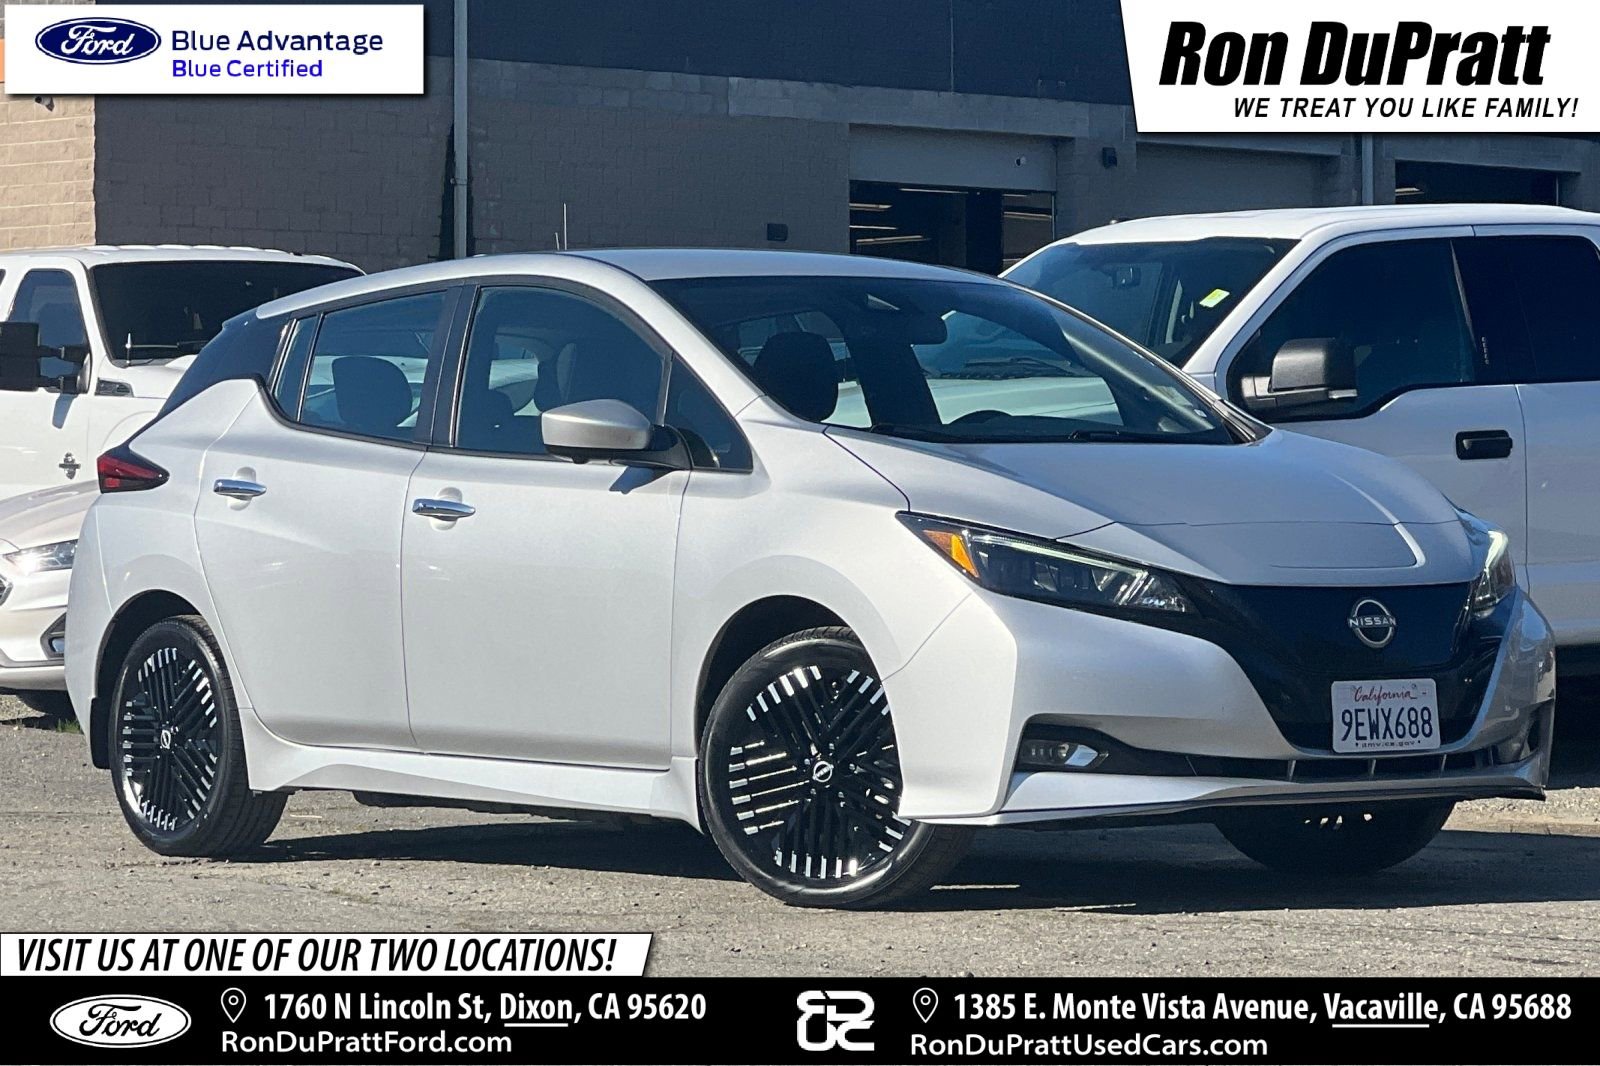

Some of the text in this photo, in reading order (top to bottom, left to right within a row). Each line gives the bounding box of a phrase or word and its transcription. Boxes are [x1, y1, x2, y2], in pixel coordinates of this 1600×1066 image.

[1350, 616, 1396, 627] NISSAN
[1354, 685, 1417, 705] California
[1341, 707, 1433, 741] 9EWX688
